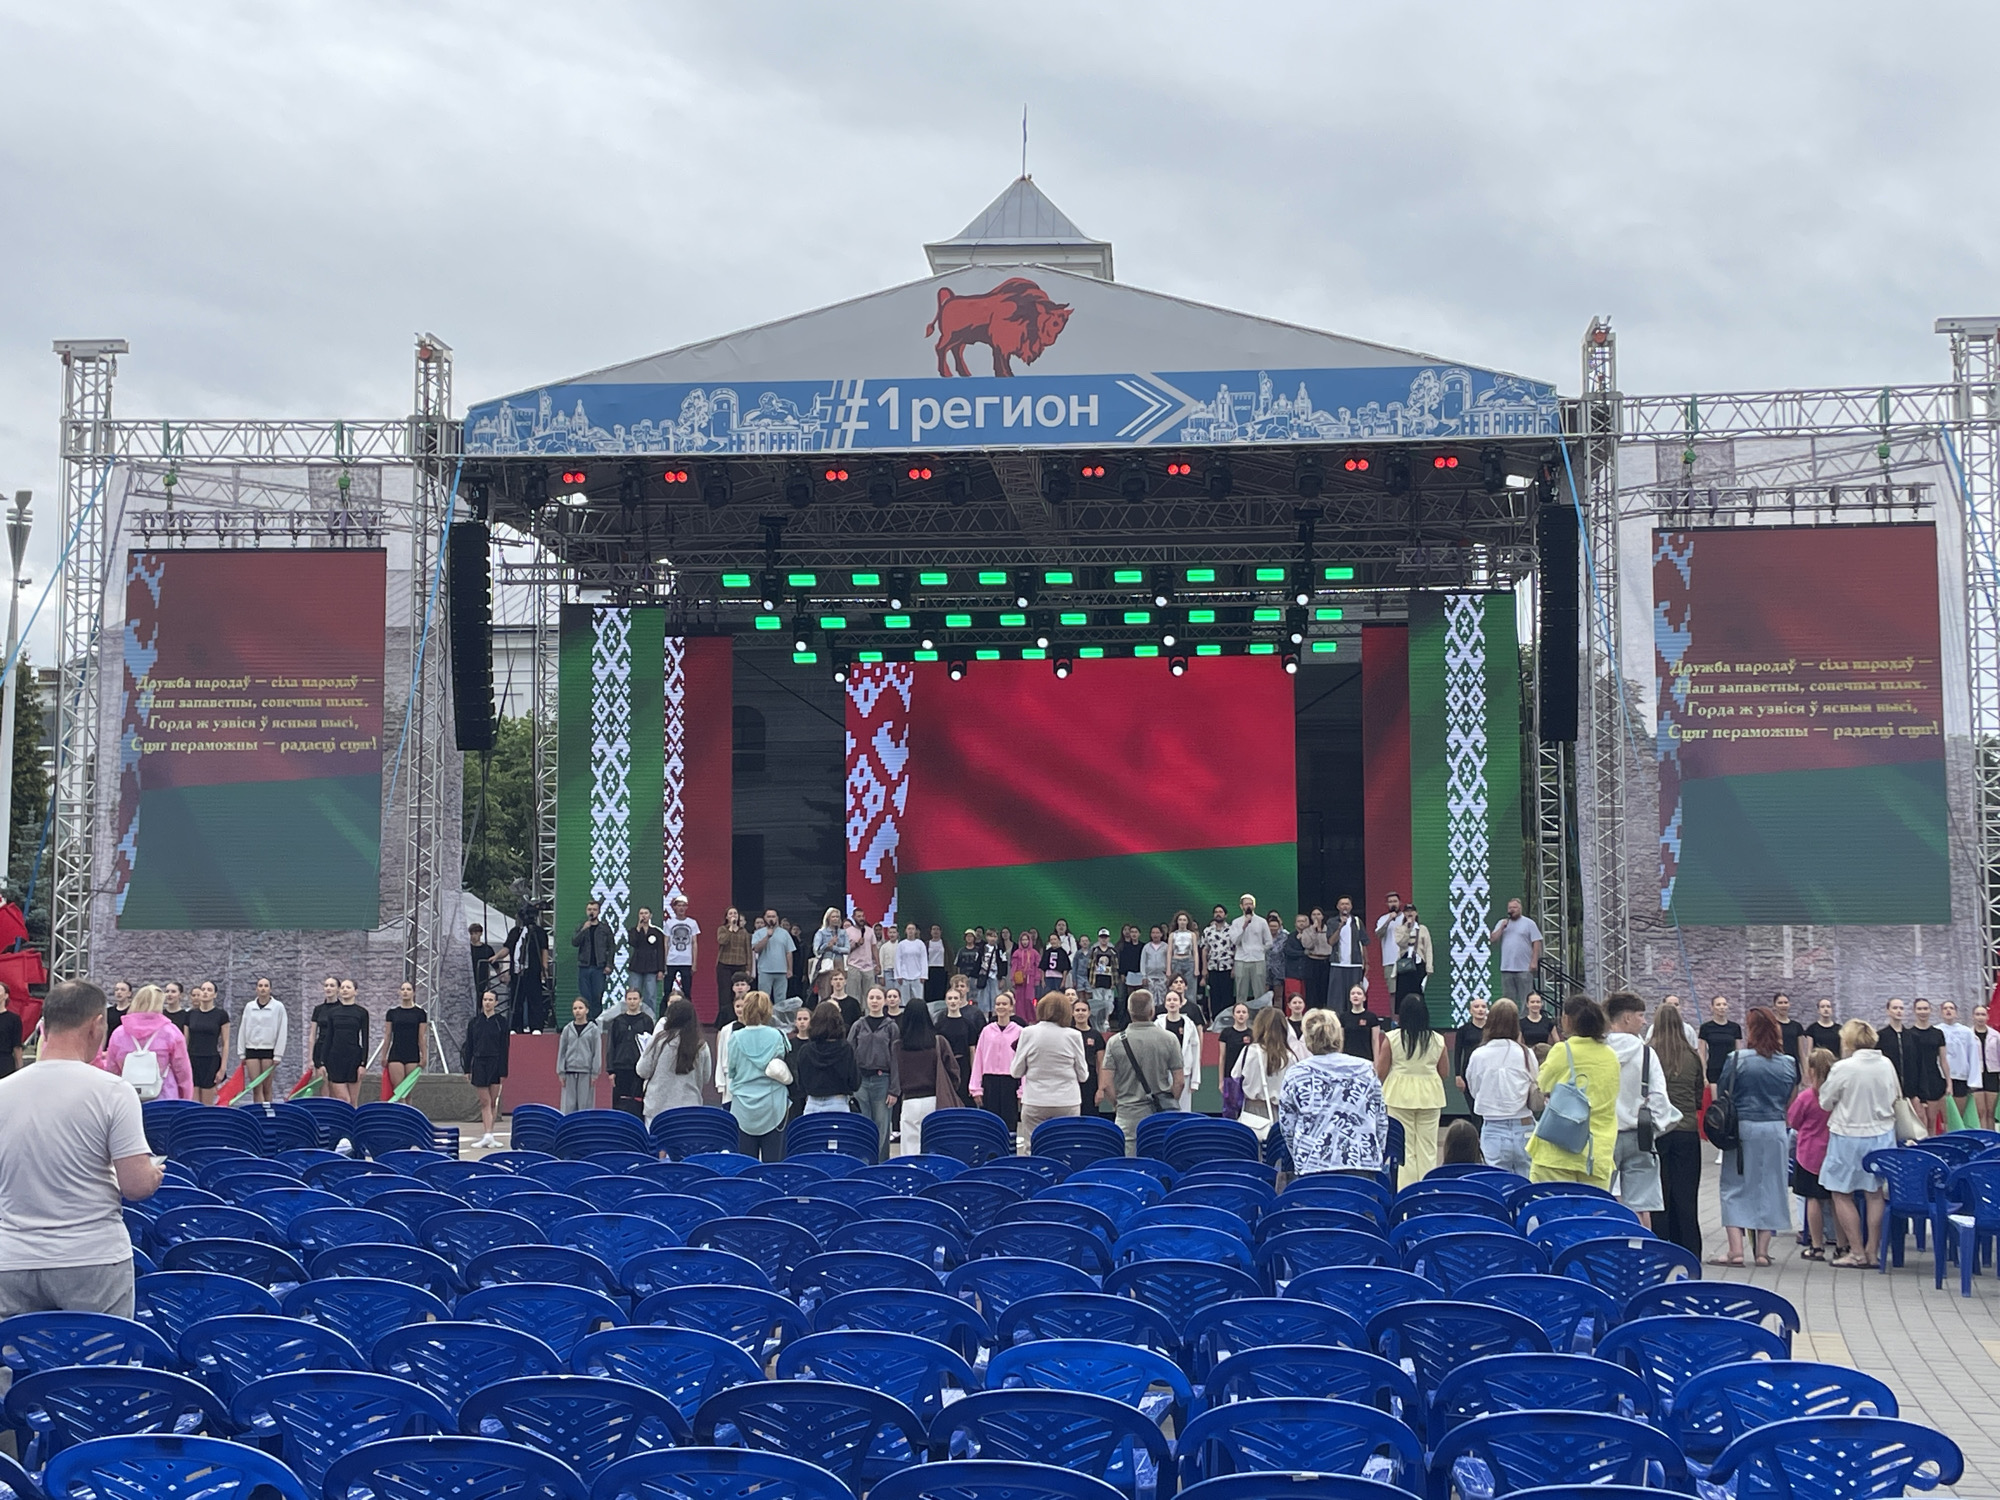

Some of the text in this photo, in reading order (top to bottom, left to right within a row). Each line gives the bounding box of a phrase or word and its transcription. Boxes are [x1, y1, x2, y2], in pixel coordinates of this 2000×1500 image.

[1669, 659, 1731, 677] Дружба
[1735, 658, 1796, 676] народаў
[1852, 656, 1915, 673] народаў
[135, 675, 191, 692] Дружба
[195, 674, 251, 692] народаў
[271, 675, 299, 688] сіла
[301, 674, 358, 691] народаў
[1676, 680, 1714, 694] Наш
[1718, 683, 1805, 695] запаветны,
[1809, 681, 1876, 692] сонечны
[140, 694, 174, 709] Наш
[178, 699, 257, 710] запаветны,
[1687, 701, 1735, 720] Горда
[1739, 705, 1753, 715] ж
[1757, 701, 1806, 718] узвіся
[1809, 700, 1819, 717] ў
[1822, 703, 1872, 714] ясныя
[149, 714, 193, 733] Горда
[196, 719, 209, 729] ж
[212, 715, 256, 732] узвіся
[259, 715, 268, 732] ў
[272, 719, 317, 729] ясныя
[1667, 723, 1709, 742] Сцяг
[1712, 727, 1809, 742] пераможны
[1833, 721, 1895, 740] радасці
[131, 737, 167, 755] Сцяг
[170, 741, 258, 755] пераможны
[280, 736, 336, 754] радасці
[1048, 955, 1058, 970] 5
[1346, 1080, 1368, 1106] 2021
[1330, 1114, 1357, 1139] 2021
